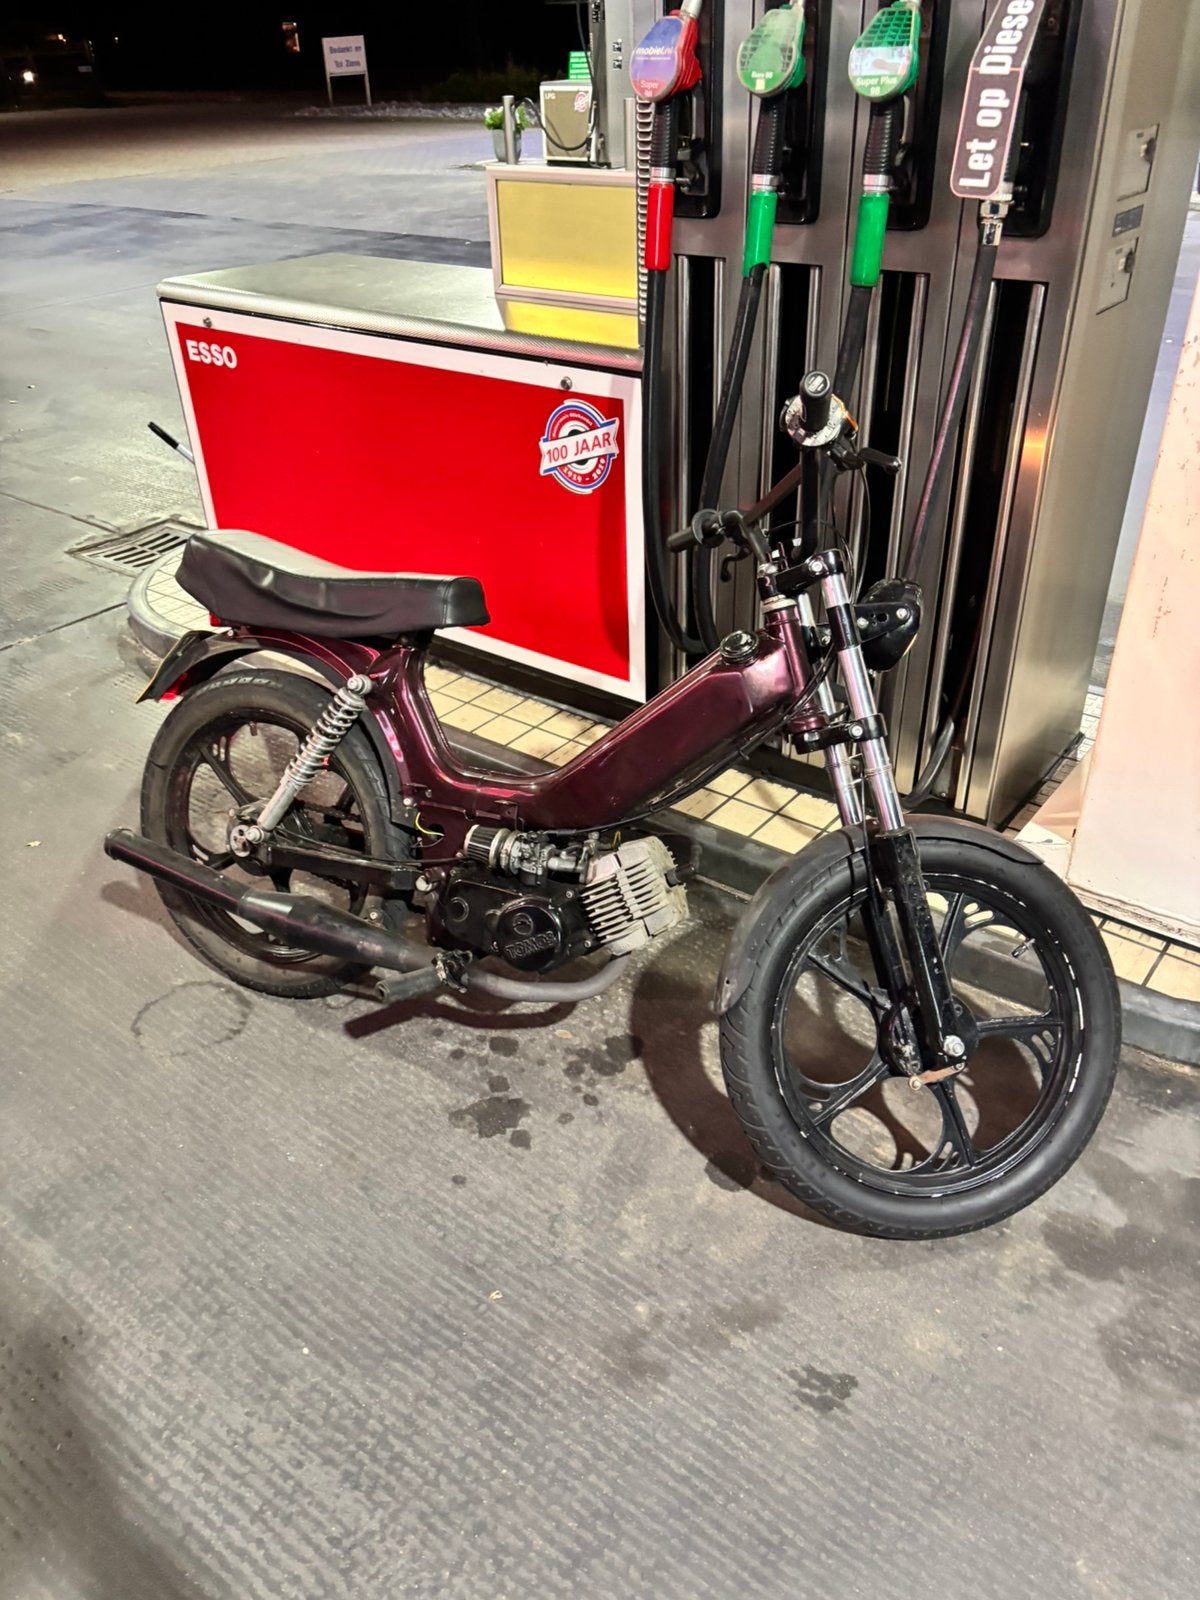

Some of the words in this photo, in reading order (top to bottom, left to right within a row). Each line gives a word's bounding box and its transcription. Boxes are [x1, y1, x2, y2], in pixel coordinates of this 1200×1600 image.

[976, 88, 1010, 128] op
[958, 138, 997, 188] Let
[185, 339, 238, 369] ESSO
[546, 444, 568, 464] 100
[574, 432, 611, 457] JAAR
[505, 930, 557, 959] TOMOS
